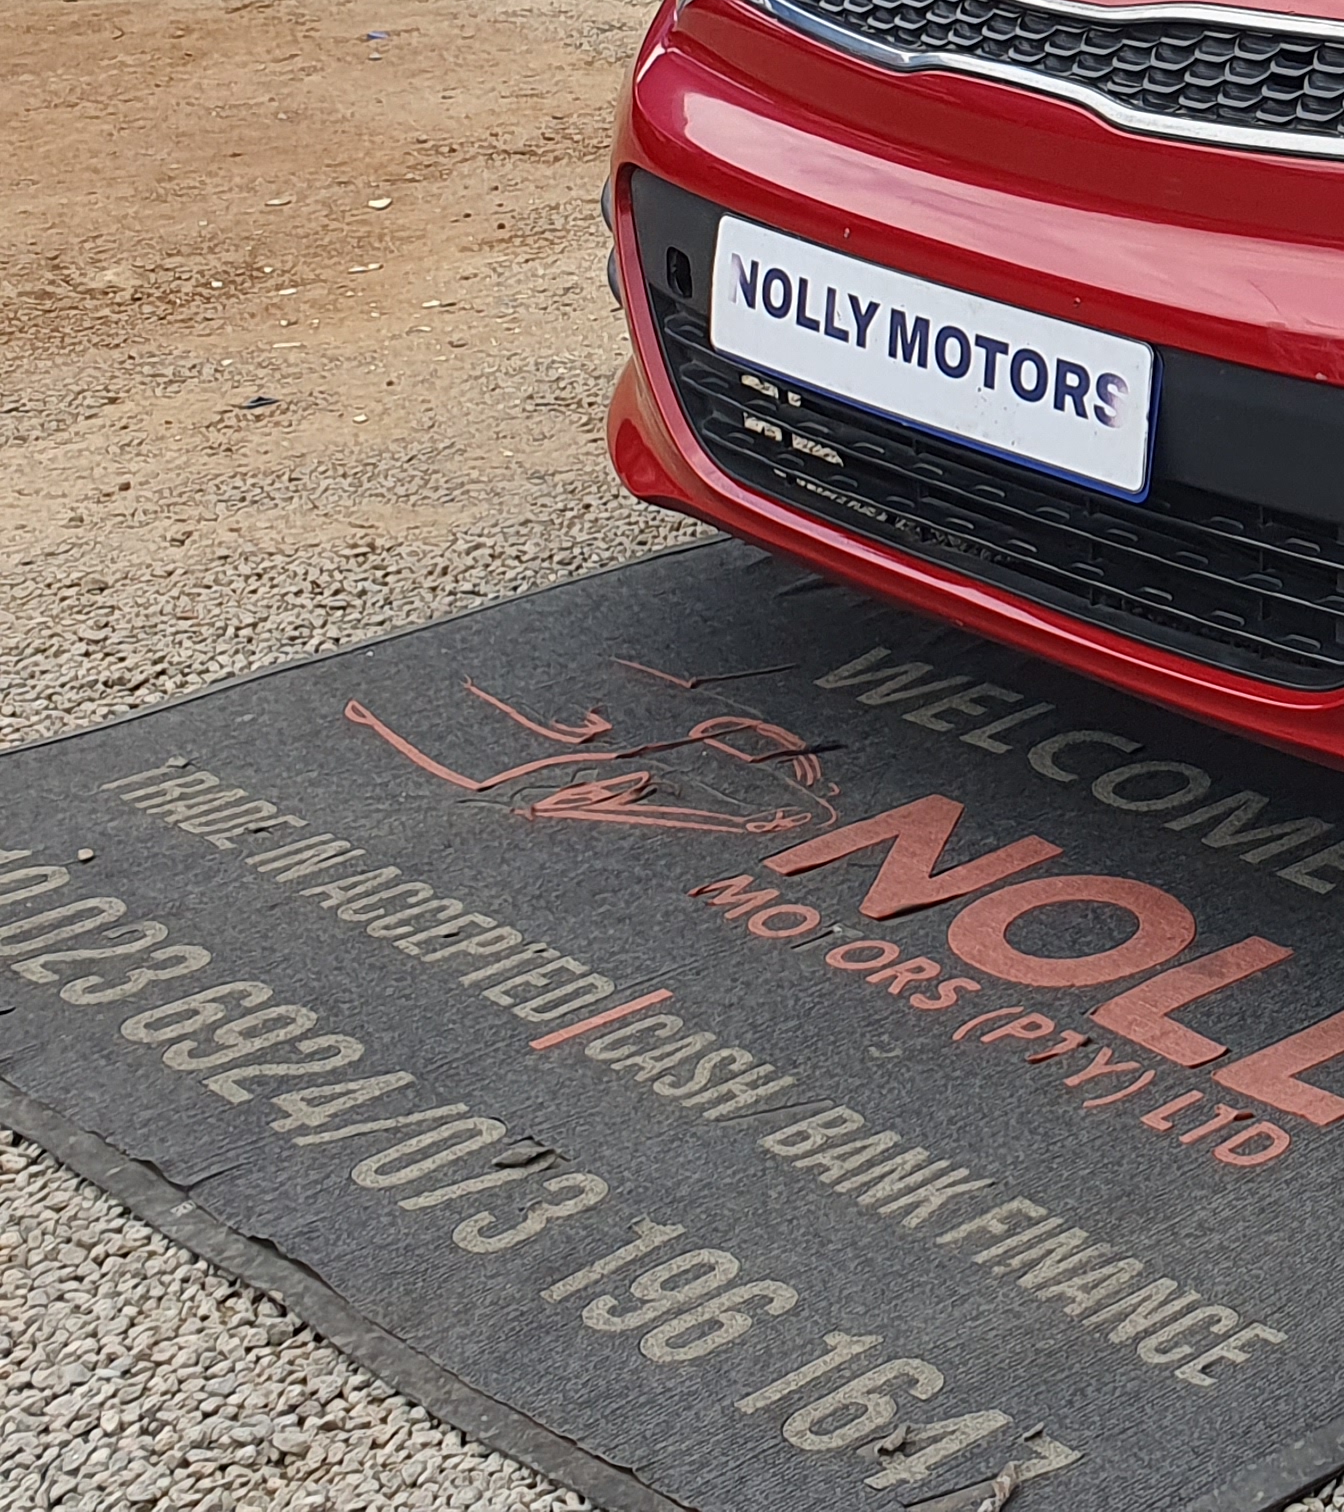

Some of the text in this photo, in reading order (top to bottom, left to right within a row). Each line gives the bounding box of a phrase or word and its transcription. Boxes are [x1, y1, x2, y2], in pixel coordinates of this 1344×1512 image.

[730, 252, 1130, 428] NOLLY MOTORS
[101, 756, 309, 850] TRADE
[245, 833, 366, 882] IN
[935, 1195, 1288, 1388] FINANCE
[952, 1006, 1156, 1109] (PTY)
[1140, 1090, 1291, 1166] LTD
[539, 1216, 799, 1364] 196
